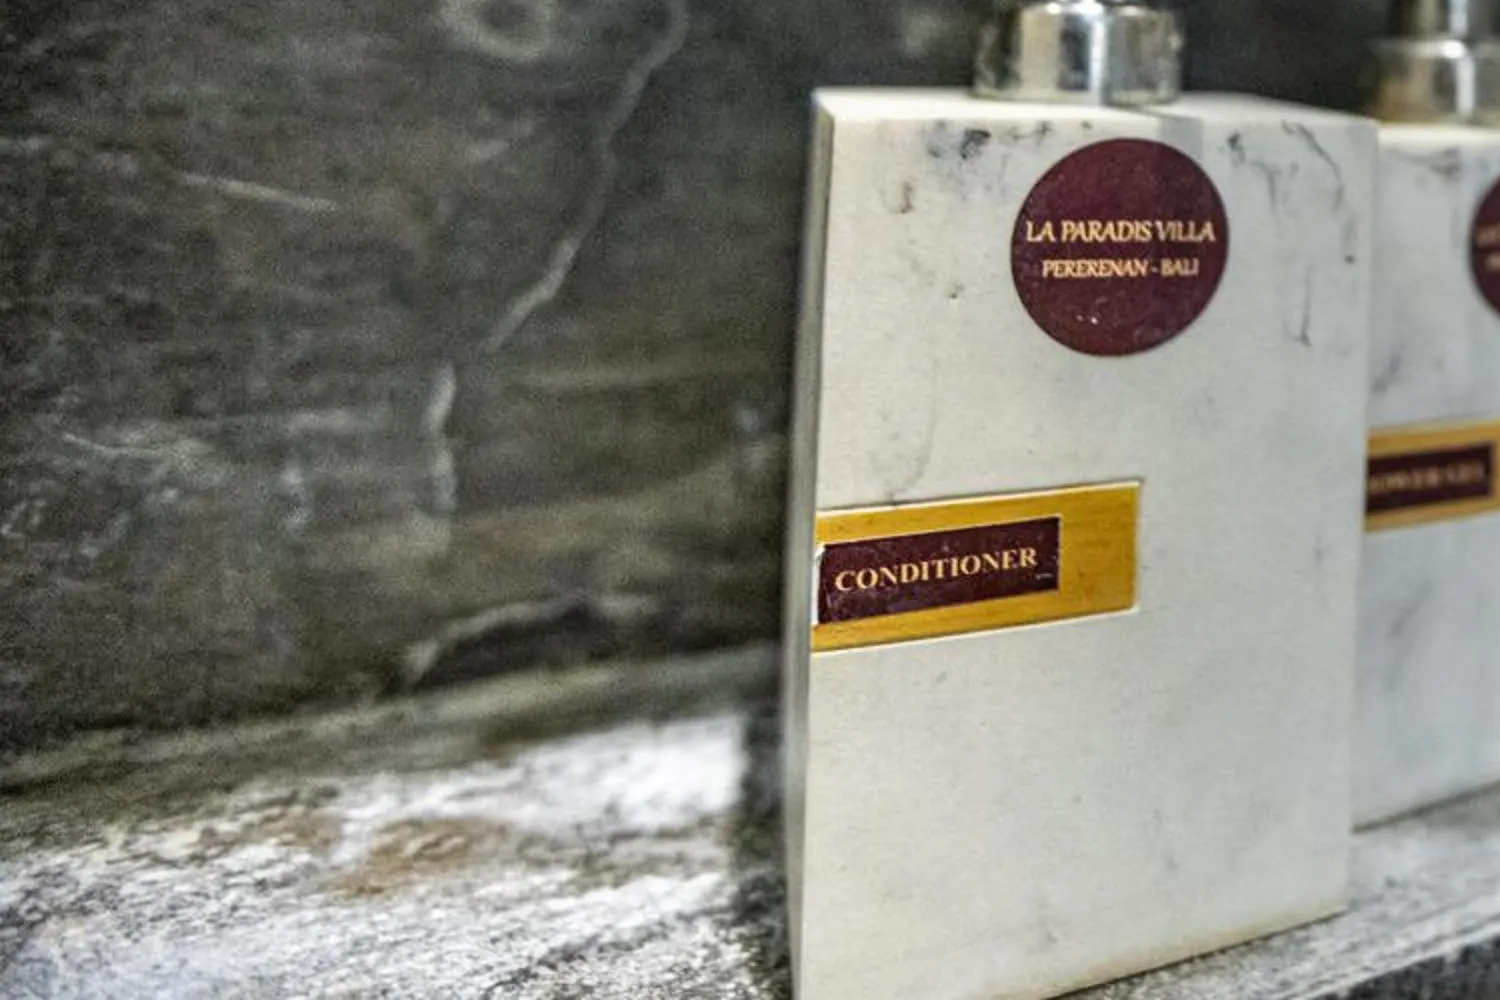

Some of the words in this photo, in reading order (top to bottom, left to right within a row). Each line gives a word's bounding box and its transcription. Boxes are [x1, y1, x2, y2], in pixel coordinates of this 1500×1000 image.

[1025, 219, 1057, 243] LA
[1060, 219, 1153, 243] PARADIS
[1154, 219, 1217, 243] VILLA
[1041, 258, 1149, 279] PERERENAN
[1160, 257, 1200, 278] BALI
[834, 546, 1039, 593] CONDITIONER
